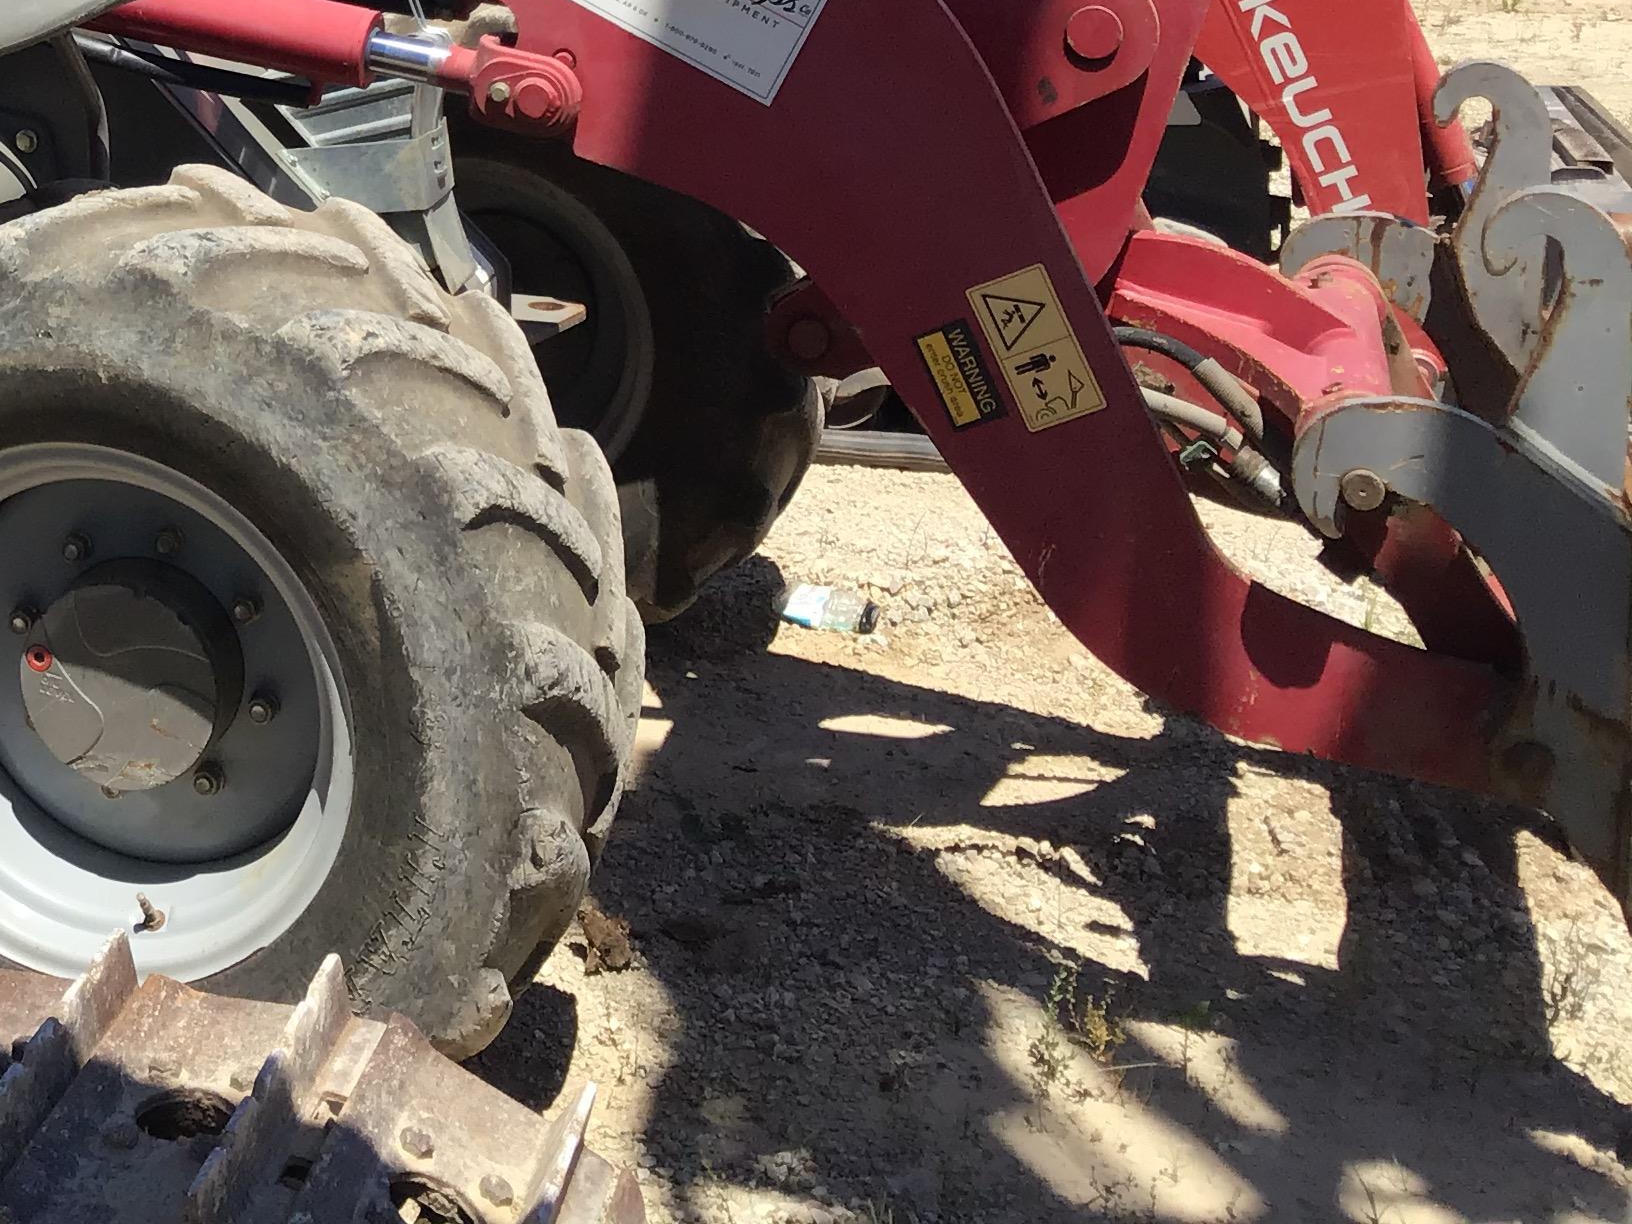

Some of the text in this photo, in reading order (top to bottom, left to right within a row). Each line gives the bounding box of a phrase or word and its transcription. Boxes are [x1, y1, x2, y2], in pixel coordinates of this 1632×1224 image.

[942, 355, 967, 394] DO NOT
[949, 328, 996, 414] WARNING
